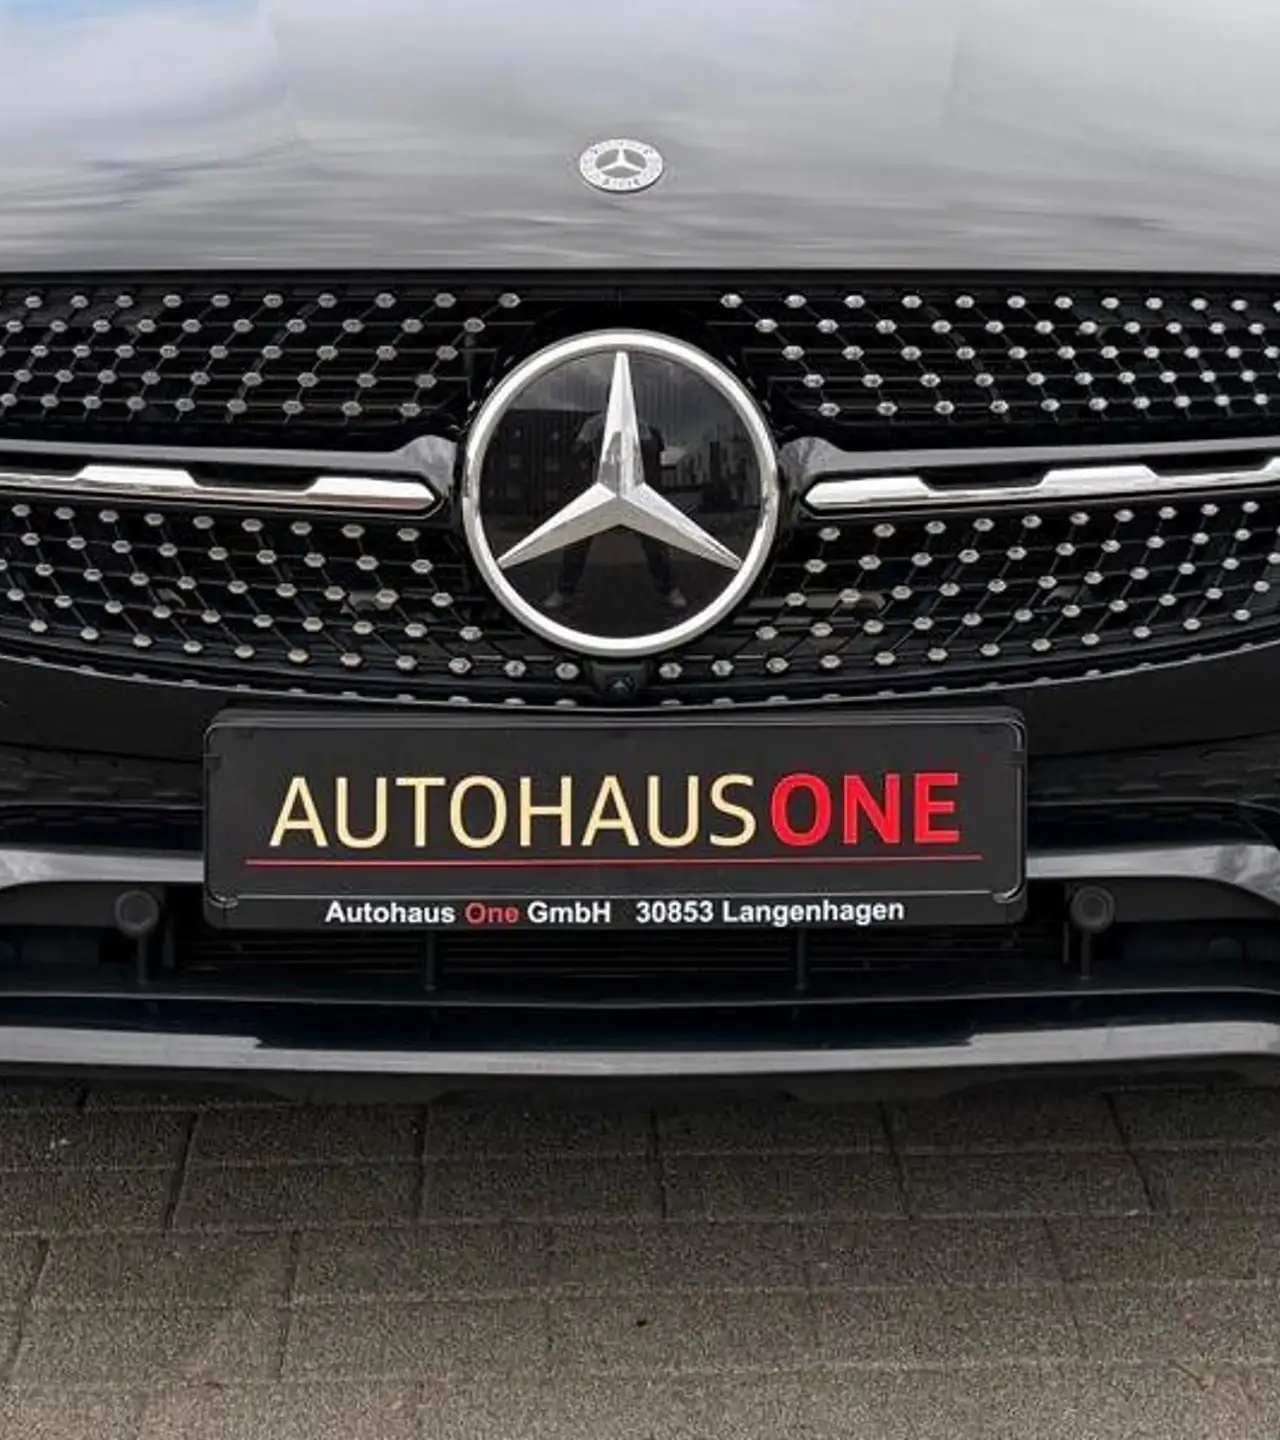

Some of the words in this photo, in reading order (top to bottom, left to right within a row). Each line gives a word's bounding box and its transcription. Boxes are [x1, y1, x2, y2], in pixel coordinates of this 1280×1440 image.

[325, 899, 456, 924] Autohaus
[464, 901, 519, 925] One
[526, 899, 611, 924] GmbH
[635, 900, 714, 924] 30853
[722, 898, 905, 928] Langenhagen
